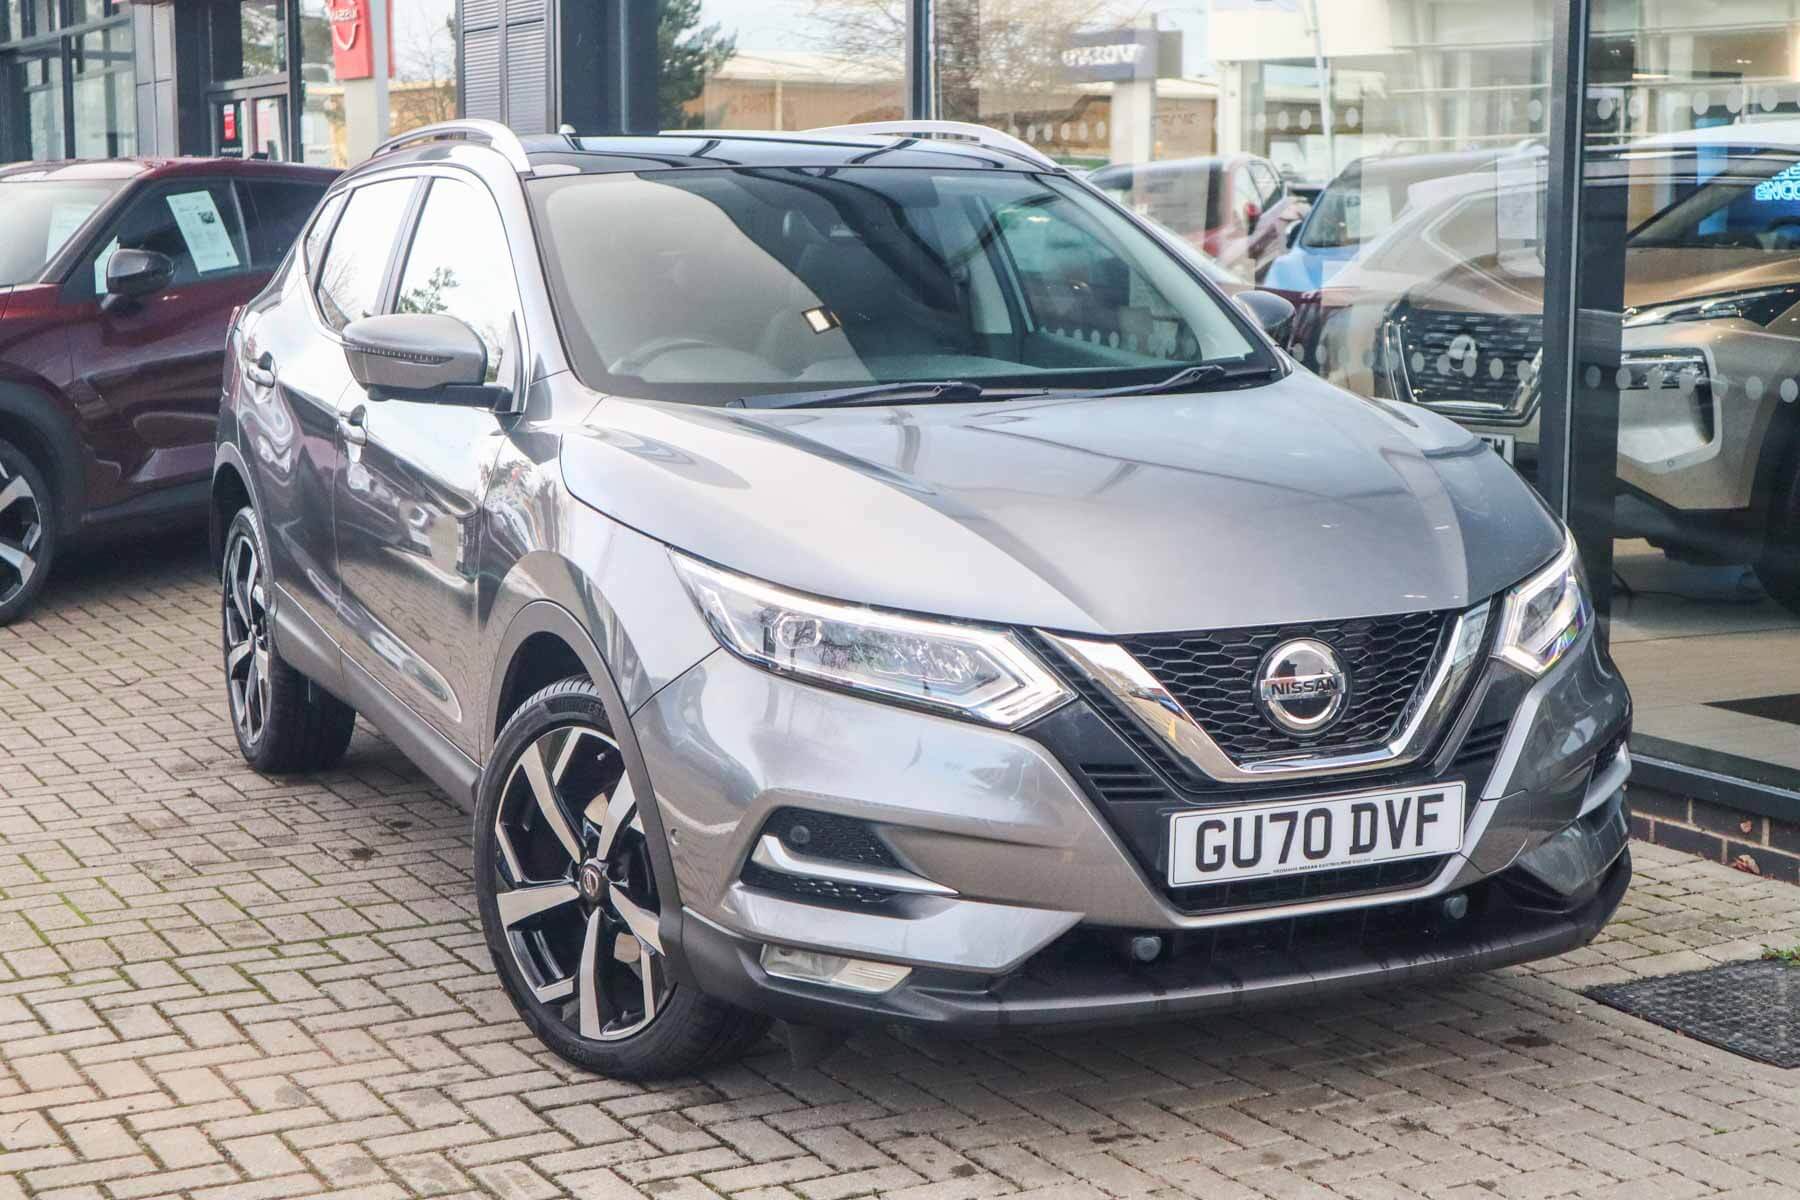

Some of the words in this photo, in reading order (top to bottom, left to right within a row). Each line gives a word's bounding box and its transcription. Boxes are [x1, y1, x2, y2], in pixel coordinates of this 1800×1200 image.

[1271, 677, 1338, 695] NISSAN
[1195, 807, 1332, 873] GU70
[1349, 793, 1444, 855] DVF
